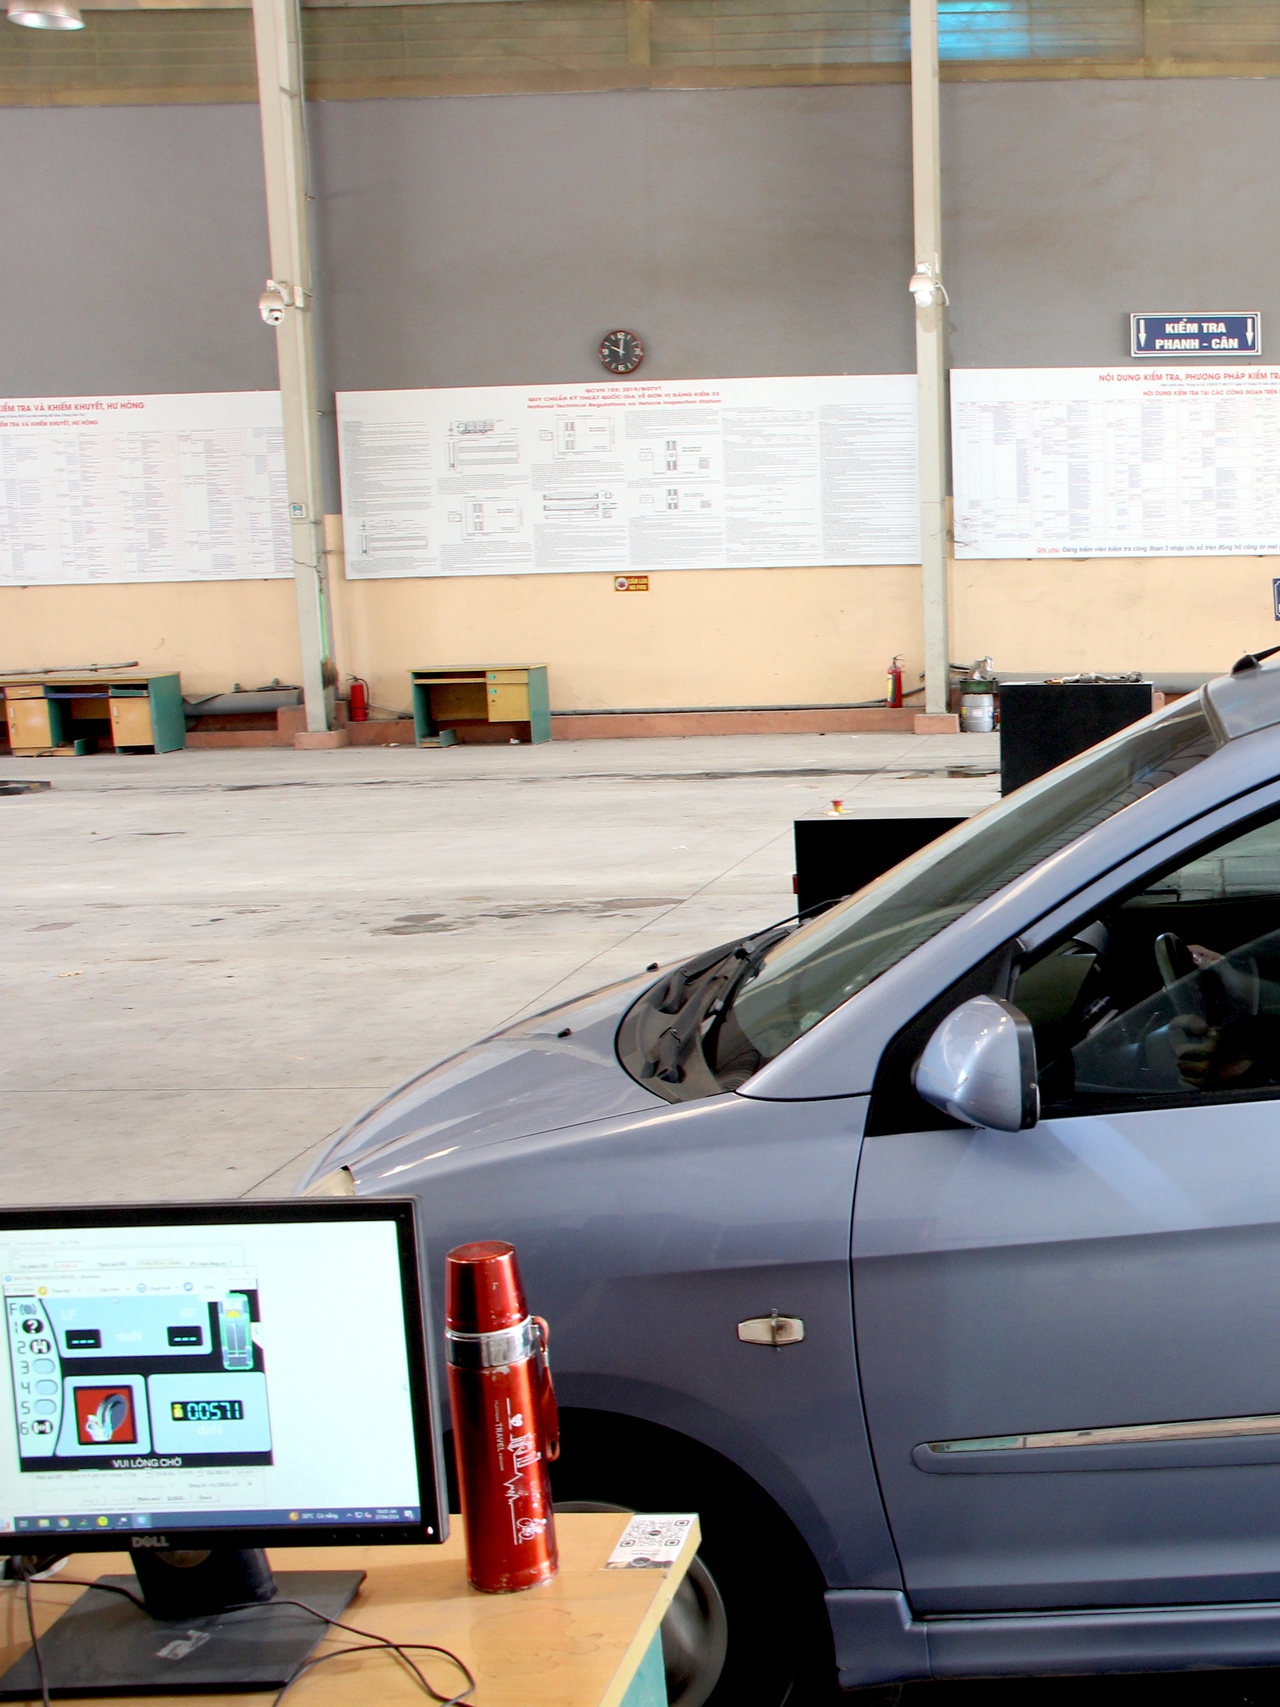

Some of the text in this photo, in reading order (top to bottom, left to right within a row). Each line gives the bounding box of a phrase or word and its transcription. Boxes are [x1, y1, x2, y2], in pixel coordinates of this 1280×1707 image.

[1165, 318, 1227, 334] KIỂM TRA
[1155, 338, 1200, 350] PHANH
[1211, 336, 1239, 349] CÂN
[1098, 373, 1115, 383] NỘI
[1143, 370, 1163, 381] KIỂM
[1223, 371, 1246, 379] PHÁP
[1247, 369, 1268, 379] KIỂM
[16, 404, 31, 412] TRA
[33, 403, 45, 411] VÀ
[106, 402, 118, 410] HƯ
[9, 1303, 17, 1316] F
[17, 1341, 26, 1354] 2
[21, 1360, 29, 1374] 3
[187, 1402, 240, 1420] 00571
[20, 1421, 30, 1435] 6
[494, 1422, 505, 1452] TRAVEL
[112, 1459, 129, 1468] VUI
[132, 1536, 170, 1548] DELL
